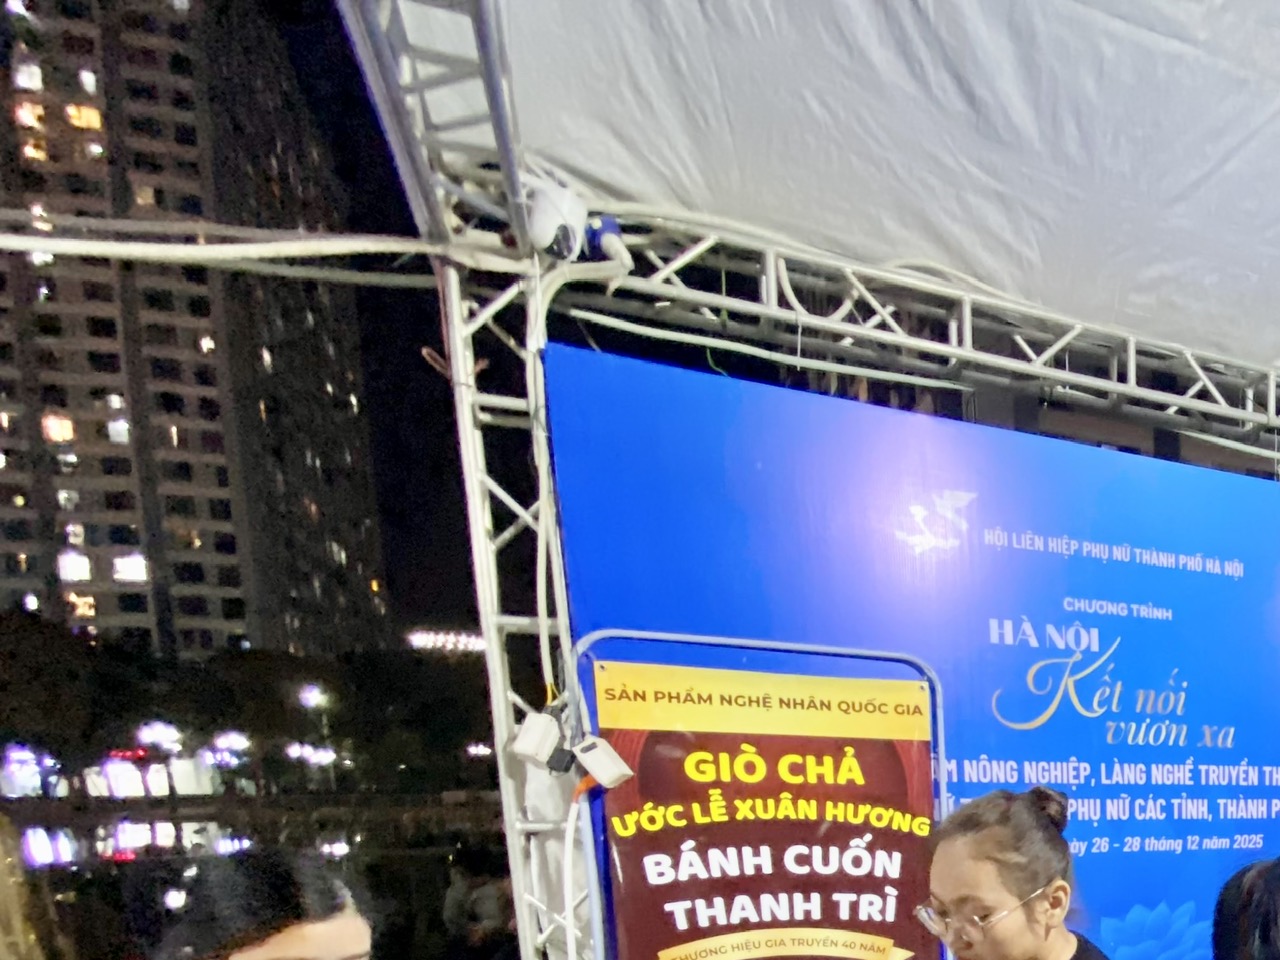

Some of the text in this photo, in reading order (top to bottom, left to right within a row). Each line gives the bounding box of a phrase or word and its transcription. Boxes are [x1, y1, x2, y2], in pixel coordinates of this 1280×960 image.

[984, 526, 1244, 581] HỘI LIÊN HIỆP PHỤ NỮ THÀNH PHỐ HÀ NỘI
[1063, 596, 1173, 620] CHƯƠNG TRÌNH
[989, 615, 1100, 654] HÀ NỘI
[604, 684, 924, 716] SẢN PHẨM NGHỆ NHÂN QUỐC GIA
[992, 636, 1188, 731] Kết nối
[1106, 718, 1236, 749] vươn xa
[684, 743, 865, 785] GIÒ CHẢ
[963, 754, 1018, 784] NÔNG
[1023, 756, 1096, 791] NGHIỆP,
[1101, 758, 1146, 785] LÀNG
[1151, 756, 1194, 786] NGHỀ
[1198, 757, 1258, 787] TRUYỀN
[611, 801, 687, 838] ƯỚC
[692, 788, 729, 824] LỄ
[734, 792, 817, 821] XUÂN
[826, 799, 931, 837] HƯƠNG
[1067, 799, 1101, 827] PHỤ
[1106, 793, 1131, 820] NỮ
[1135, 793, 1166, 820] CÁC
[1171, 792, 1212, 822] TỈNH,
[1217, 794, 1268, 820] THÀNH
[643, 833, 902, 886] BÁNH CUỐN
[1091, 837, 1109, 853] 26
[1123, 836, 1141, 852] 28
[1145, 836, 1182, 855] tháng
[1186, 835, 1200, 851] 12
[1202, 836, 1230, 851] năm
[1233, 834, 1264, 850] 2025
[664, 885, 898, 931] THANH TRÌ
[731, 940, 761, 956] HIỆU
[765, 938, 786, 948] GIA
[842, 941, 856, 950] 40
[859, 943, 886, 955] NĂM
